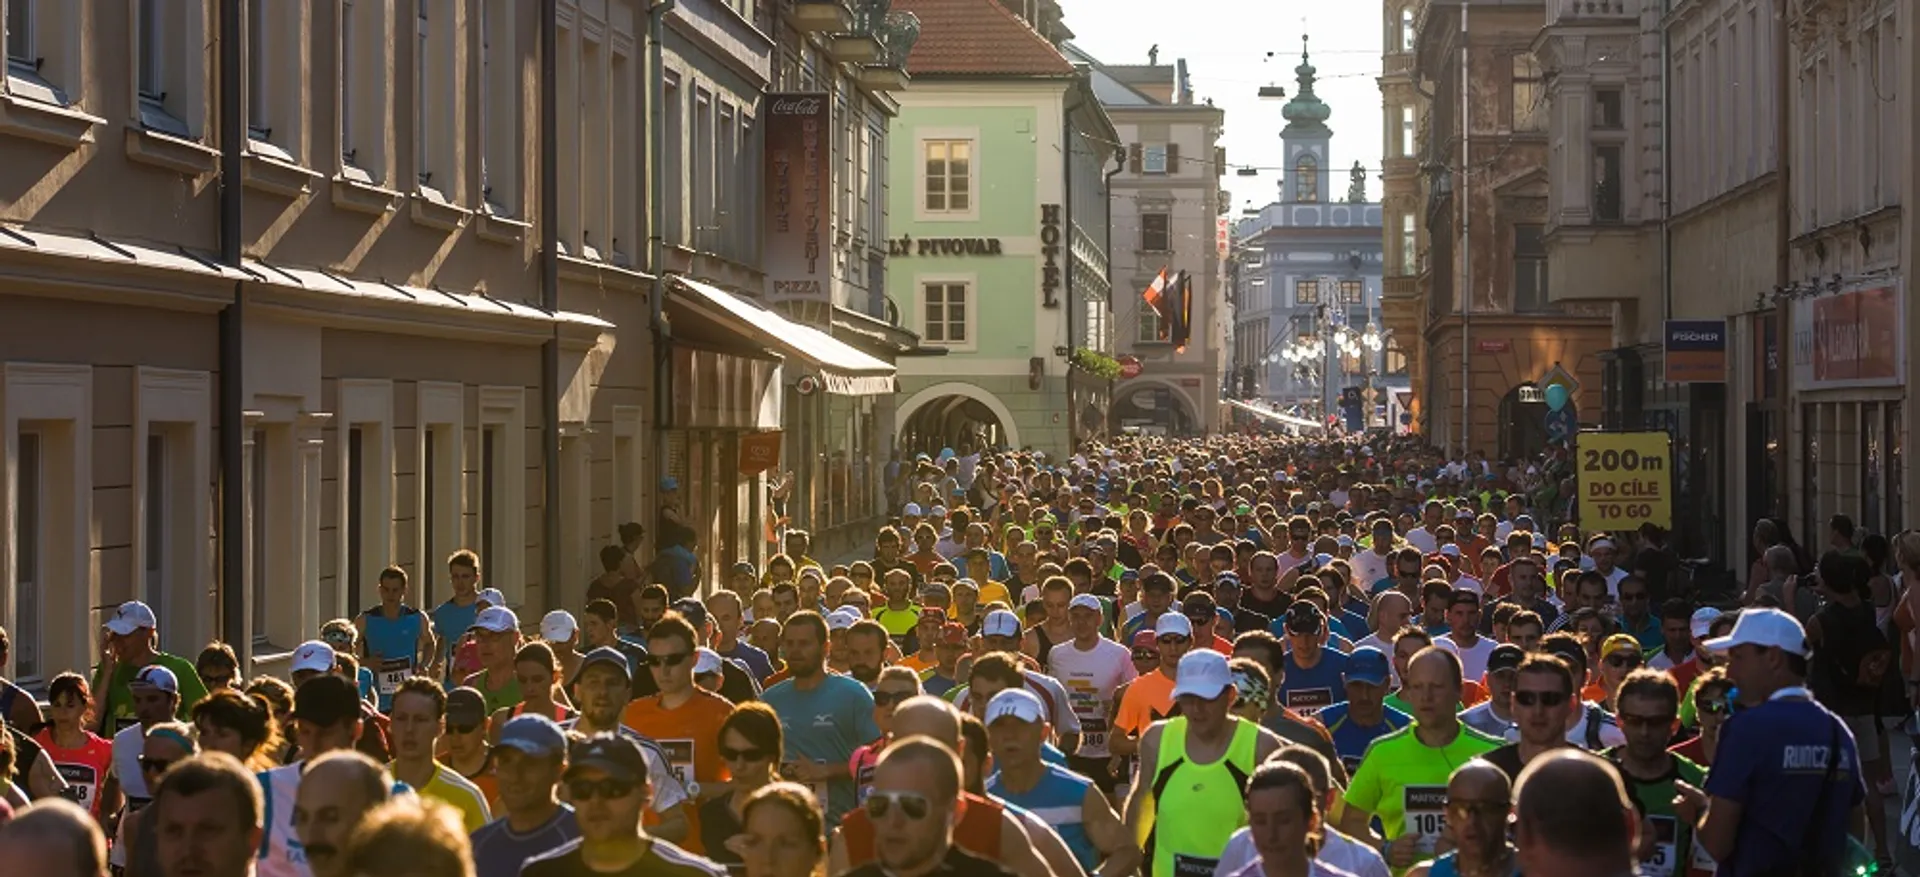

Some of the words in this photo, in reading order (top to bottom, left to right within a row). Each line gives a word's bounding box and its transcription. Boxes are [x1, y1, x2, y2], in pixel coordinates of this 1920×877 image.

[917, 238, 1001, 256] PIVOVAR
[1040, 203, 1062, 309] HOTEL
[774, 280, 821, 294] PIZZA
[1672, 331, 1719, 341] FISCHER
[1584, 449, 1663, 471] 200m
[1590, 482, 1616, 496] DO
[1620, 478, 1659, 496] CÍLE
[1597, 504, 1622, 519] TO
[1626, 503, 1652, 519] GO
